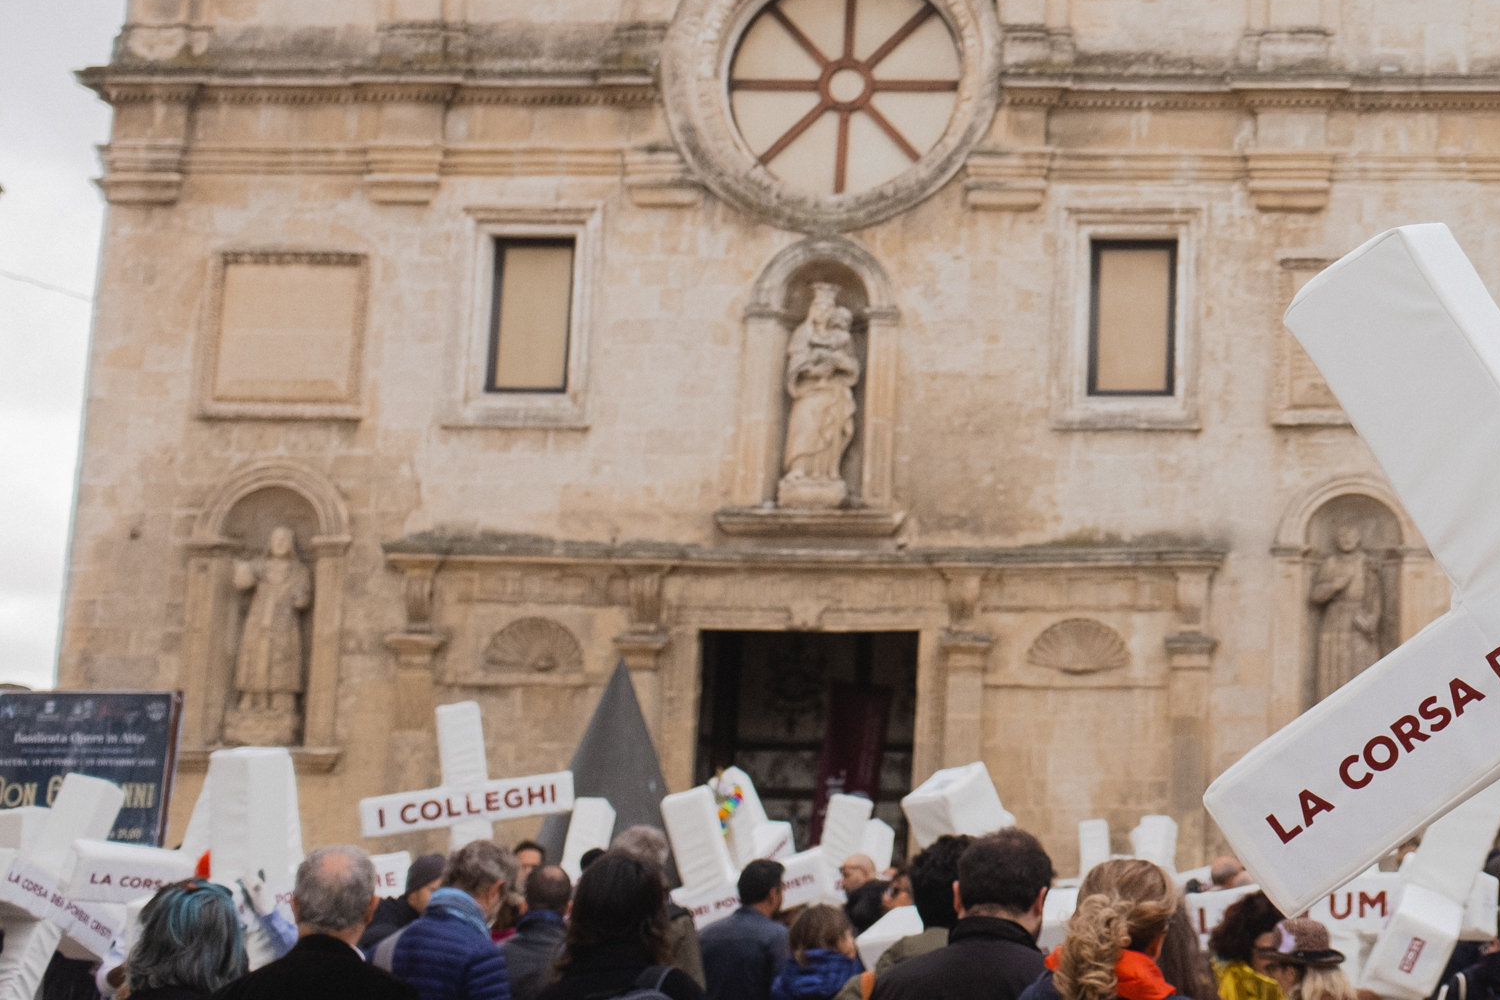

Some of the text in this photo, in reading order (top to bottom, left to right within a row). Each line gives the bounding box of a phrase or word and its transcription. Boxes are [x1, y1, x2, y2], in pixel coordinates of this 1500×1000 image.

[1266, 789, 1335, 844] LA
[1339, 678, 1485, 789] CORSA
[378, 784, 556, 828] I COLLEGHI
[8, 871, 20, 884] LA
[22, 878, 48, 898] CORSA
[90, 872, 112, 885] LA
